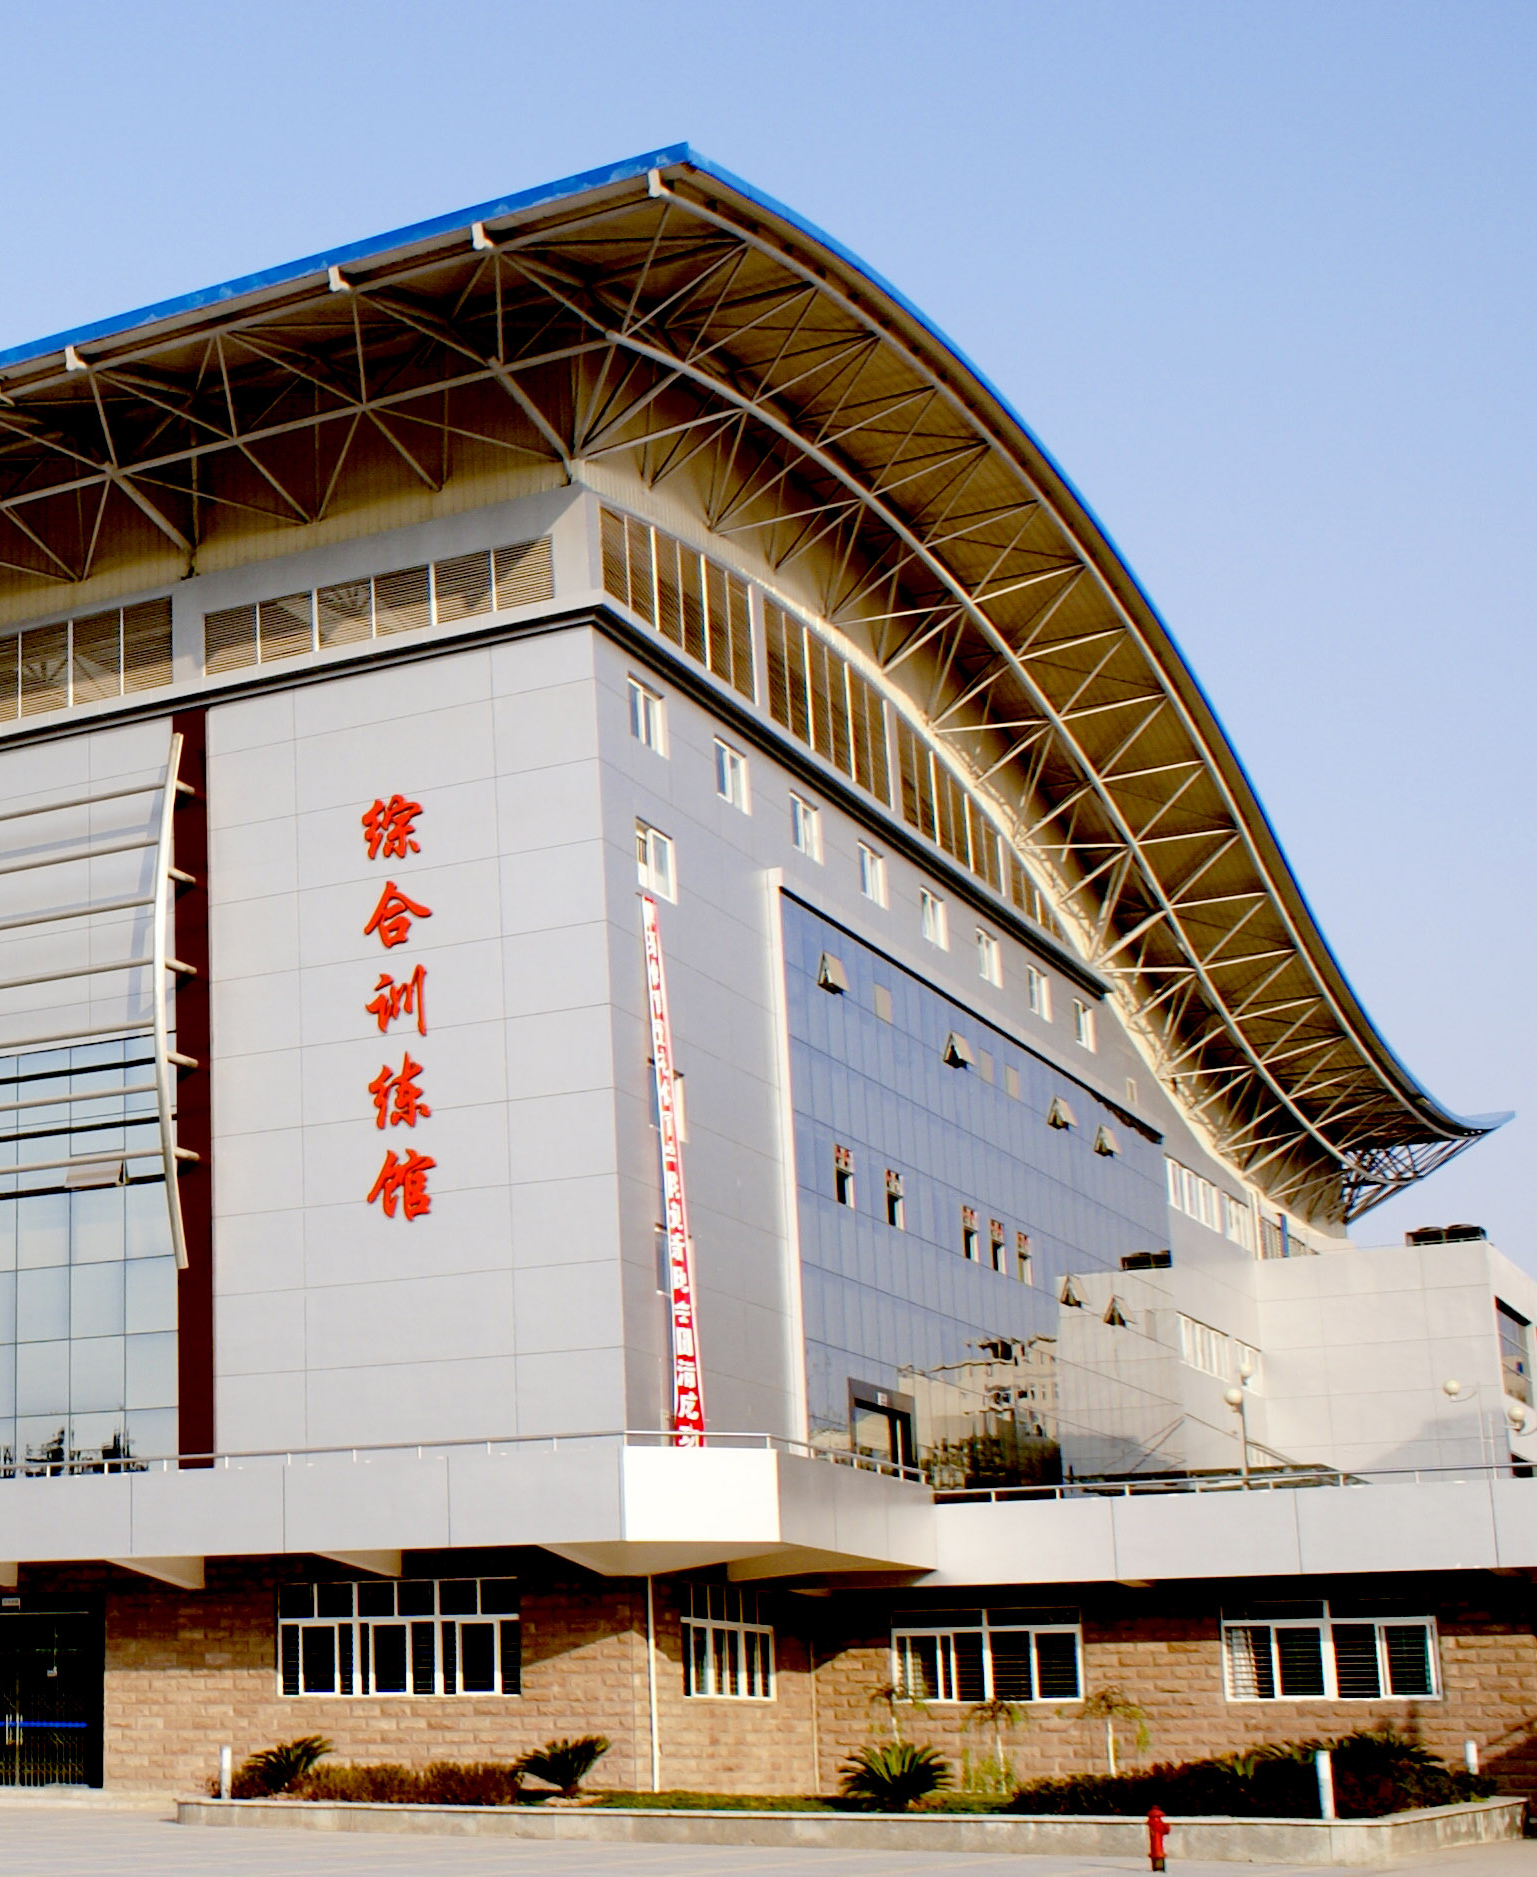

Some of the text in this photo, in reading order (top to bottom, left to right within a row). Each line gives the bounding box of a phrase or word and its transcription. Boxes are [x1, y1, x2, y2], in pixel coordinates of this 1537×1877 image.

[360, 794, 437, 1222] 综合训练馆
